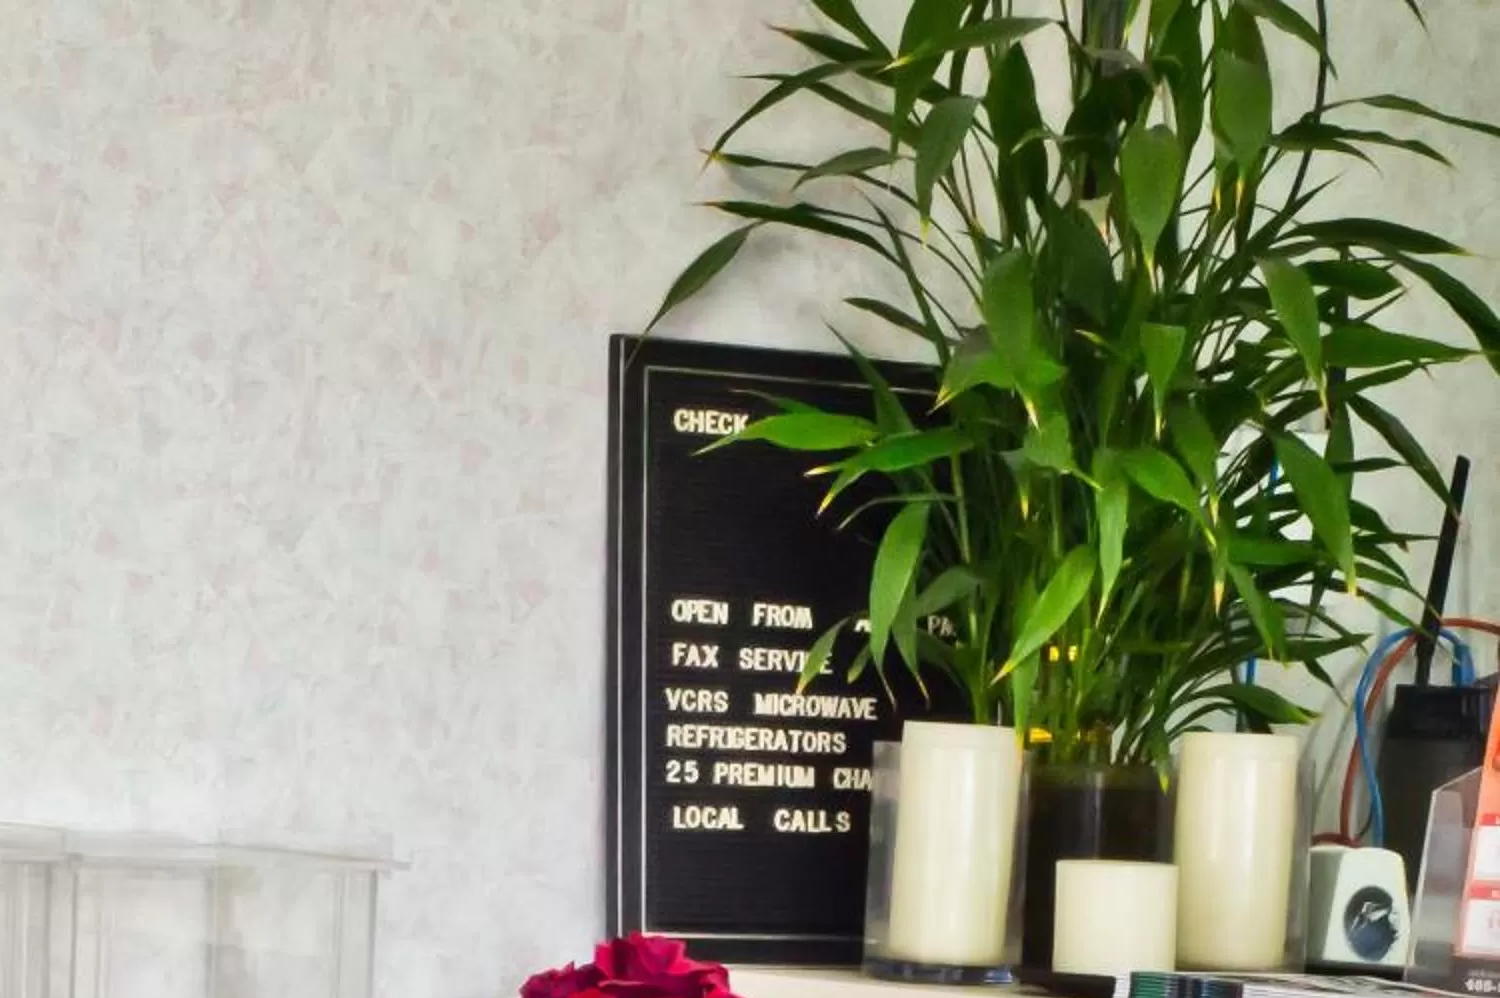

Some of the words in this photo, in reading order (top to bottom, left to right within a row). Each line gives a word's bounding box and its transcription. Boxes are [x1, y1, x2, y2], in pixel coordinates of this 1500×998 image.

[673, 408, 748, 436] CHECK
[671, 600, 728, 625] OPEN
[751, 603, 813, 629] FROM
[672, 642, 719, 668] FAX
[739, 647, 833, 674] SERVIE
[665, 687, 729, 712] VCRS
[754, 692, 878, 720] MICROWAVE
[666, 724, 846, 753] REFRIGERATORS
[665, 759, 699, 783] 25
[713, 762, 815, 788] PREMIUM
[672, 805, 744, 830] LOCAL
[773, 809, 851, 833] CALLS
